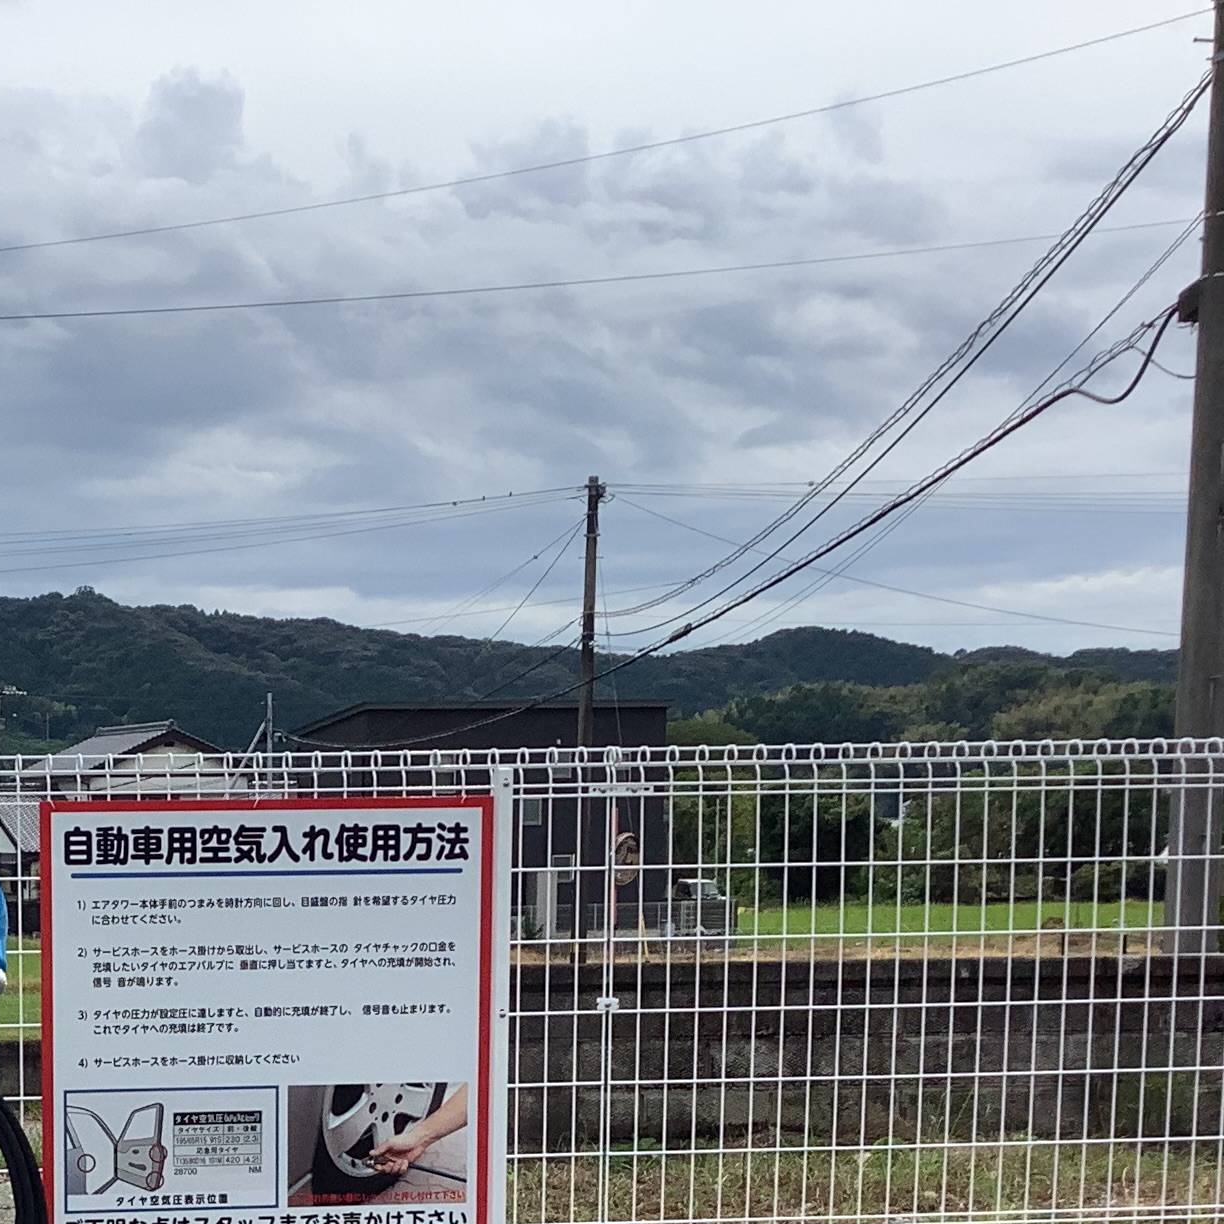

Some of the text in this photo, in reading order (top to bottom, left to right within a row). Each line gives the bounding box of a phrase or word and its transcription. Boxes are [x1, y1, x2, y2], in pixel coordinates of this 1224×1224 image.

[63, 821, 471, 867] 自動車用空気入れ使用方法
[76, 899, 87, 912] 1)
[352, 893, 457, 907] 針を希望するタイヤ圧力
[91, 913, 182, 926] に合わせてください。
[77, 947, 88, 959] 2)
[353, 940, 457, 954] タイヤチャックの口金を
[92, 959, 235, 974] 充填したいタイヤのエアバルブに
[92, 975, 179, 989] 信号 音が鳴ります。
[77, 1009, 89, 1022] 3)
[361, 1003, 451, 1016] 信号音も止まります。
[93, 1021, 239, 1036] これでタイヤへの充填は終了です。
[77, 1053, 301, 1070] 4) サービスホースをホース掛けに収納してください
[115, 1193, 229, 1207] タイヤ空気圧表示位置
